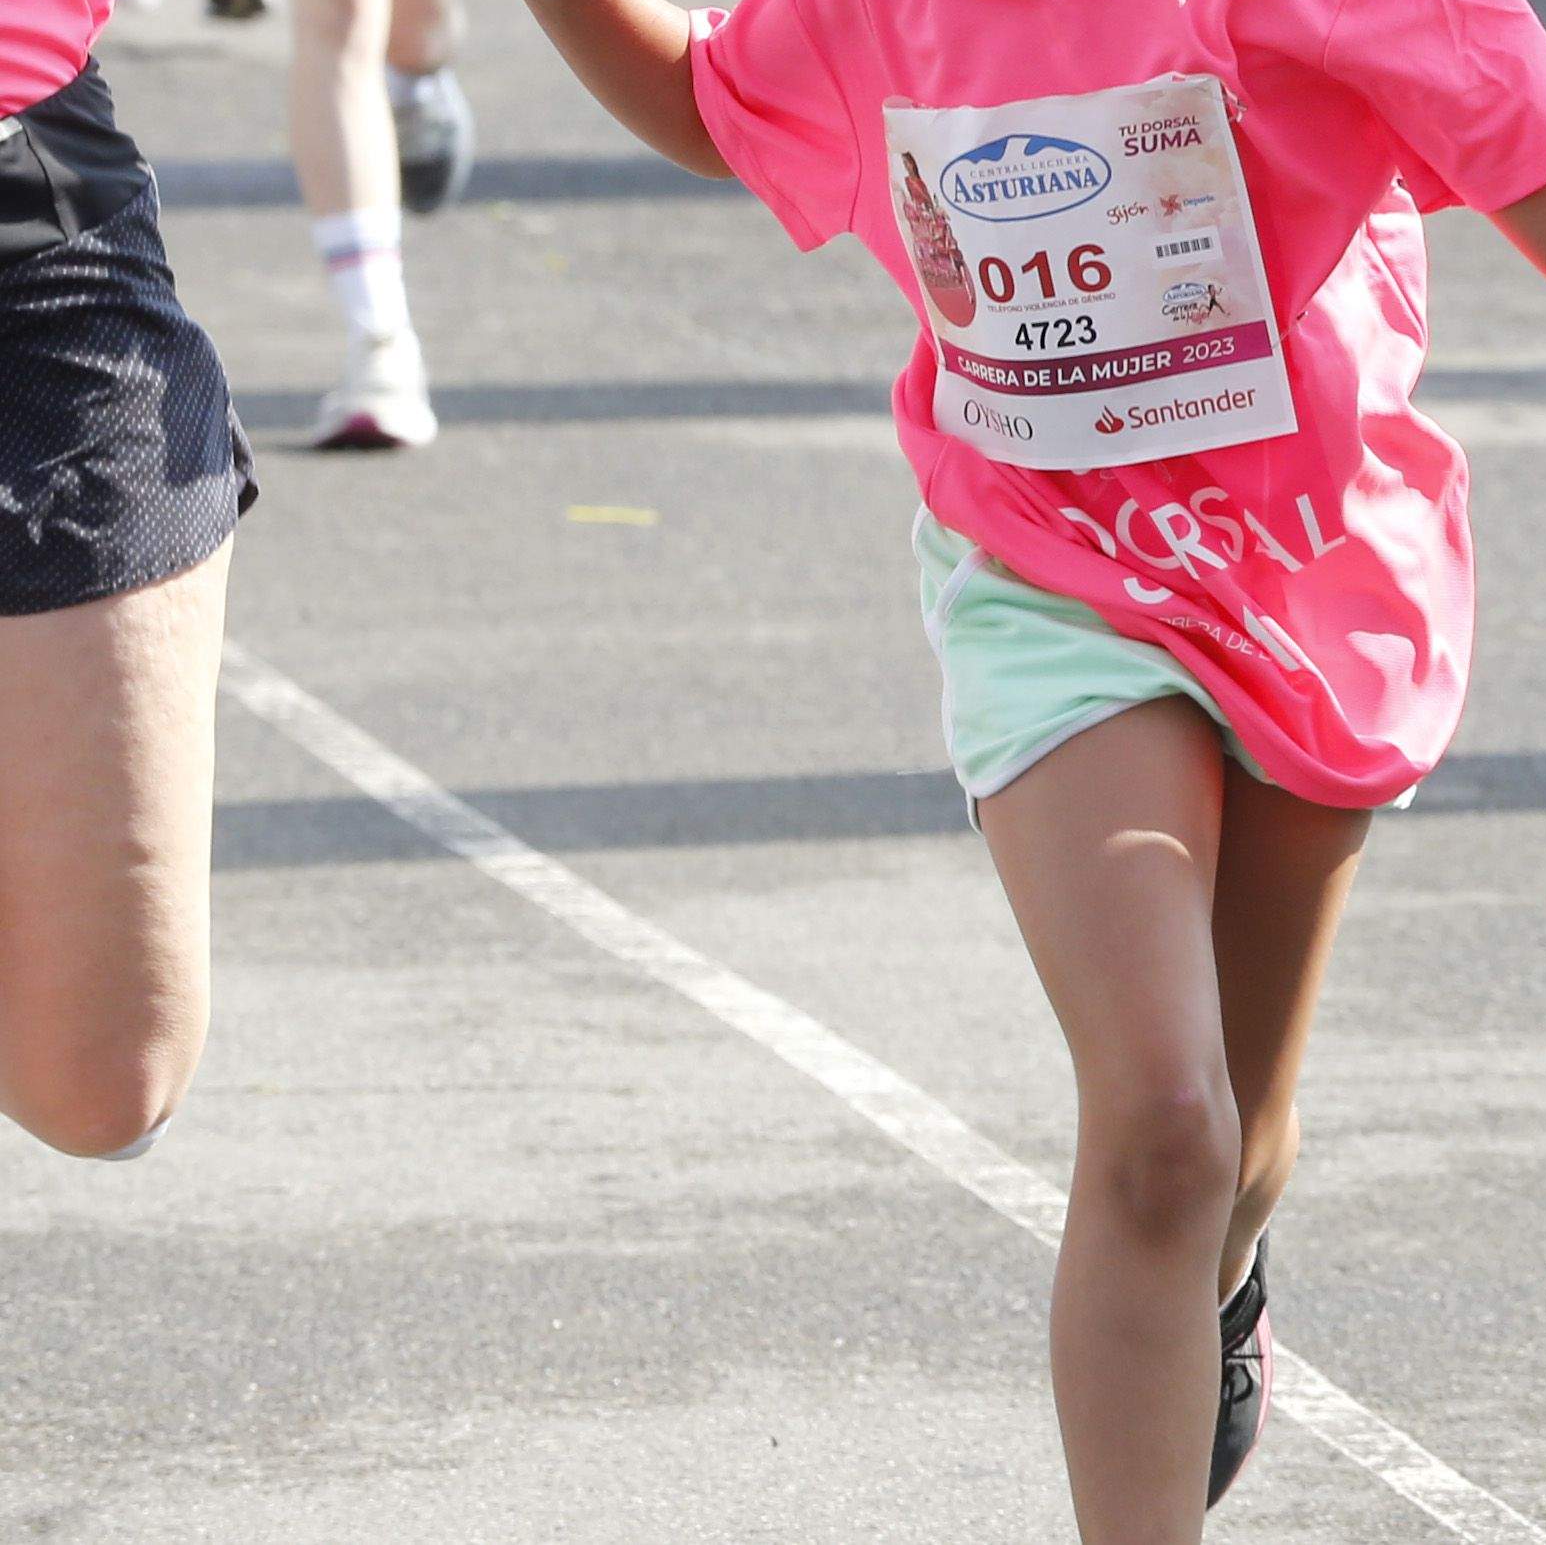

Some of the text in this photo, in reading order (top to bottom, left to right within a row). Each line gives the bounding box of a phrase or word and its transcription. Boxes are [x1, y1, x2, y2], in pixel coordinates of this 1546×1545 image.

[1118, 114, 1200, 138] TU DORSAL
[1124, 129, 1203, 157] SUMA
[953, 165, 1100, 205] ASTURIANA
[969, 154, 1090, 180] CENTRAL LECHERA
[1106, 201, 1151, 226] gijón
[978, 243, 1113, 304] 016
[1067, 297, 1080, 306] DE
[1013, 315, 1099, 352] 4723
[957, 336, 1236, 388] CARRERA DE LA MUJER 2023
[963, 400, 1035, 442] OYSHO
[1127, 387, 1258, 431] Santander
